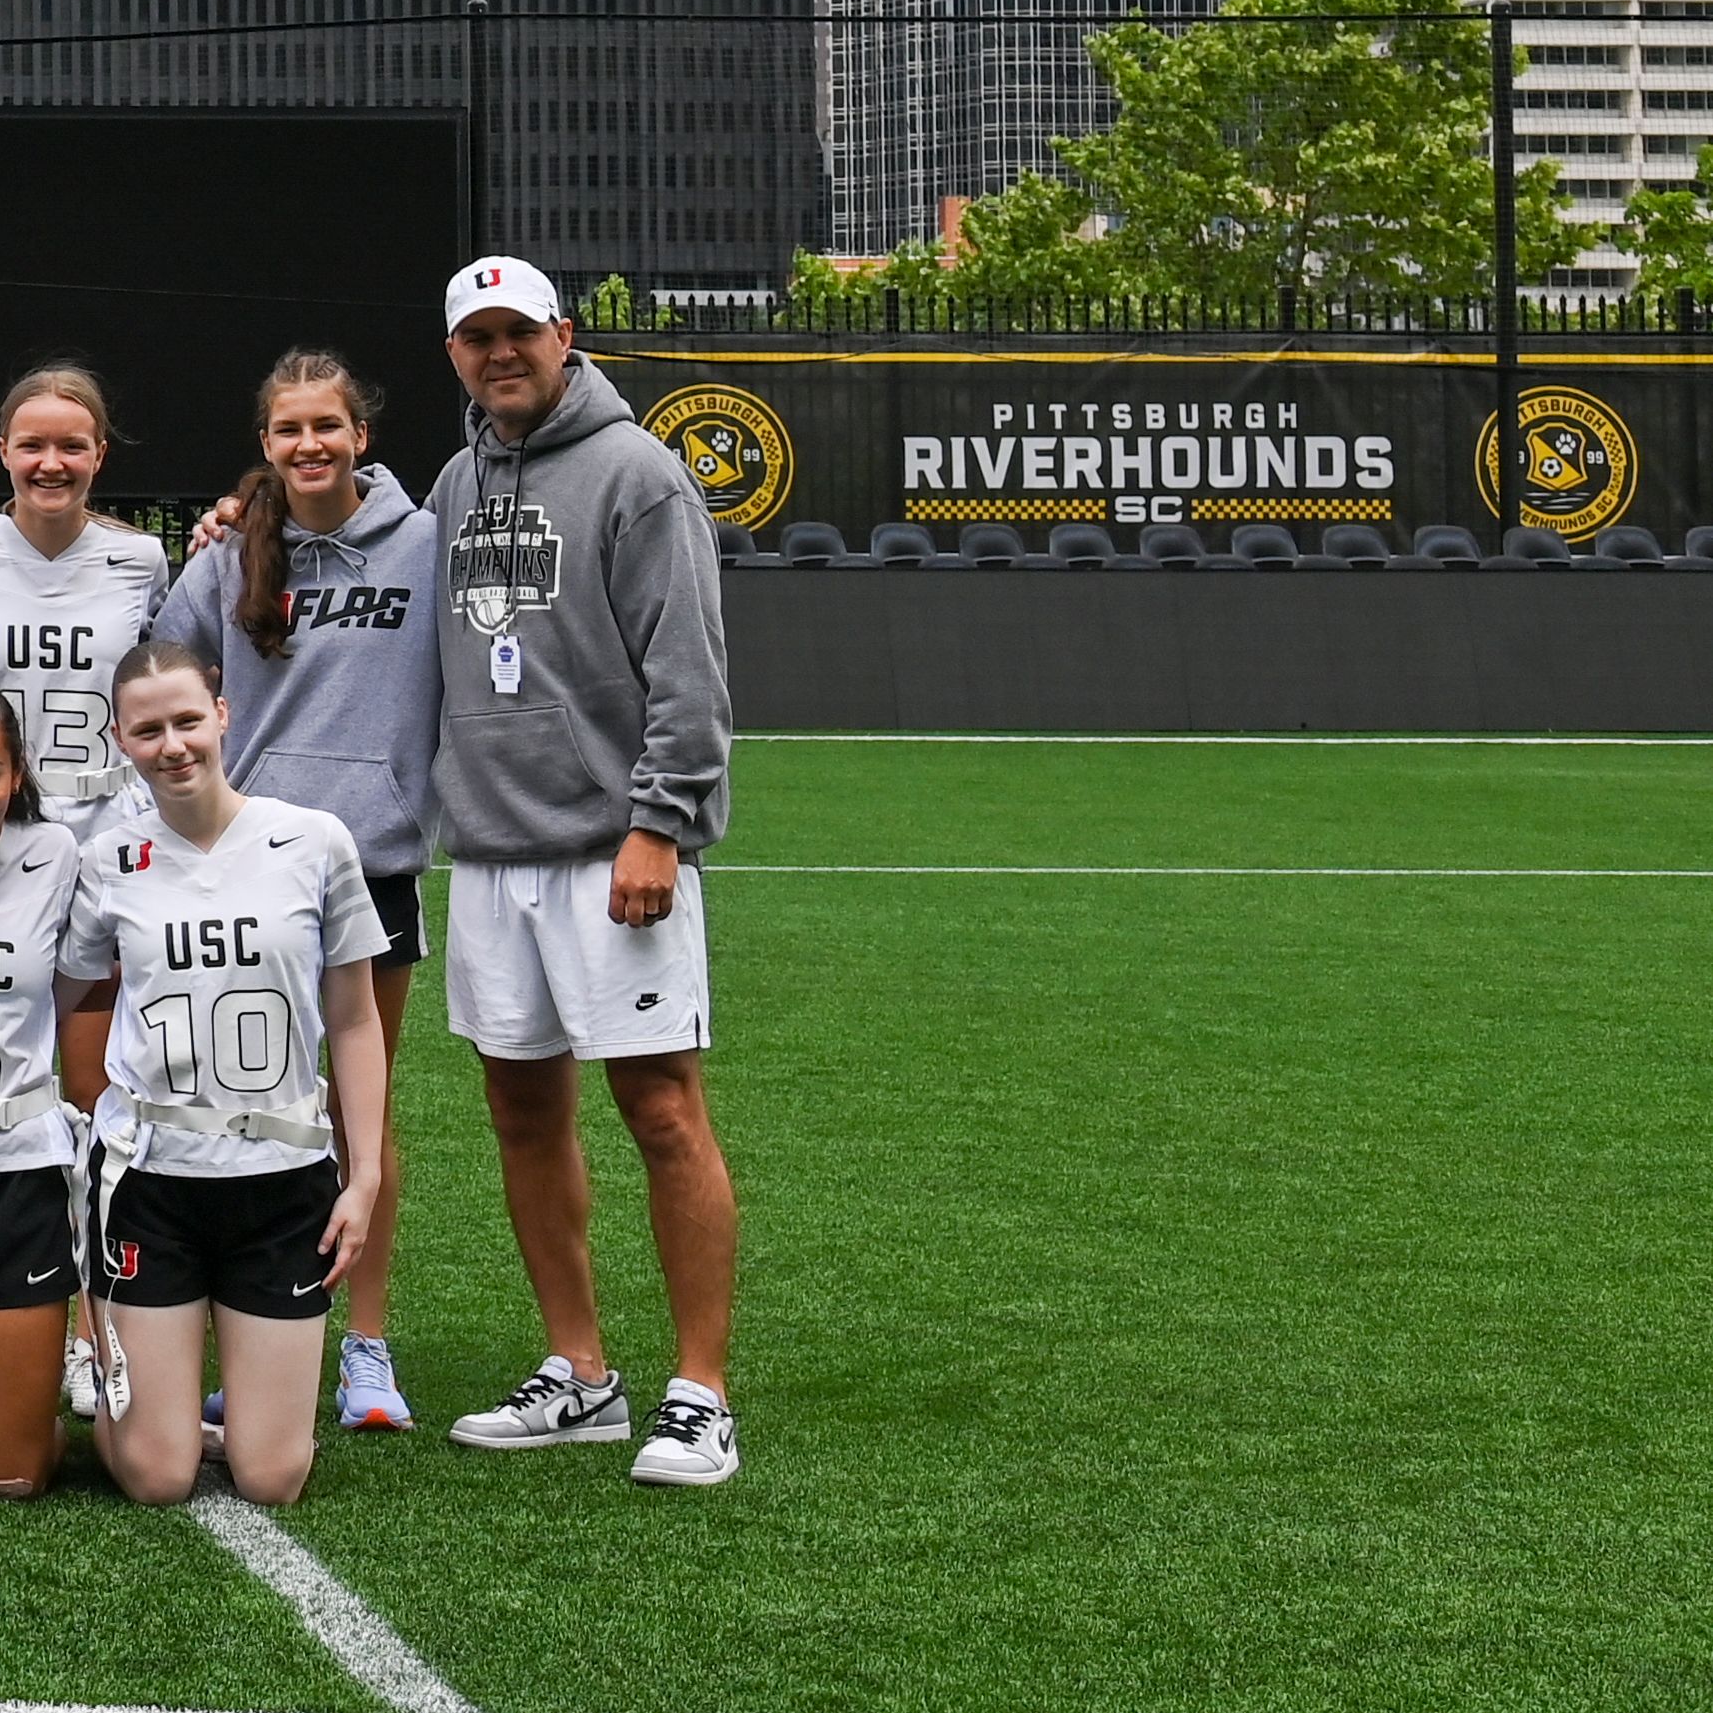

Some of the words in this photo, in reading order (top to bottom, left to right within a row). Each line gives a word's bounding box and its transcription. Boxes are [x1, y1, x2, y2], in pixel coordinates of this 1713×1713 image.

[661, 396, 764, 430] PITTSBURGH
[993, 403, 1298, 429] PITTSBURGH
[1519, 399, 1606, 431] TTSBURGH
[903, 436, 1394, 489] RIVERHOUNDS
[750, 492, 768, 510] SC
[1115, 496, 1183, 523] SC
[1595, 495, 1613, 513] SC
[286, 587, 411, 637] FLAG
[8, 625, 93, 670] USC
[165, 917, 261, 970] USC
[140, 988, 291, 1095] 10
